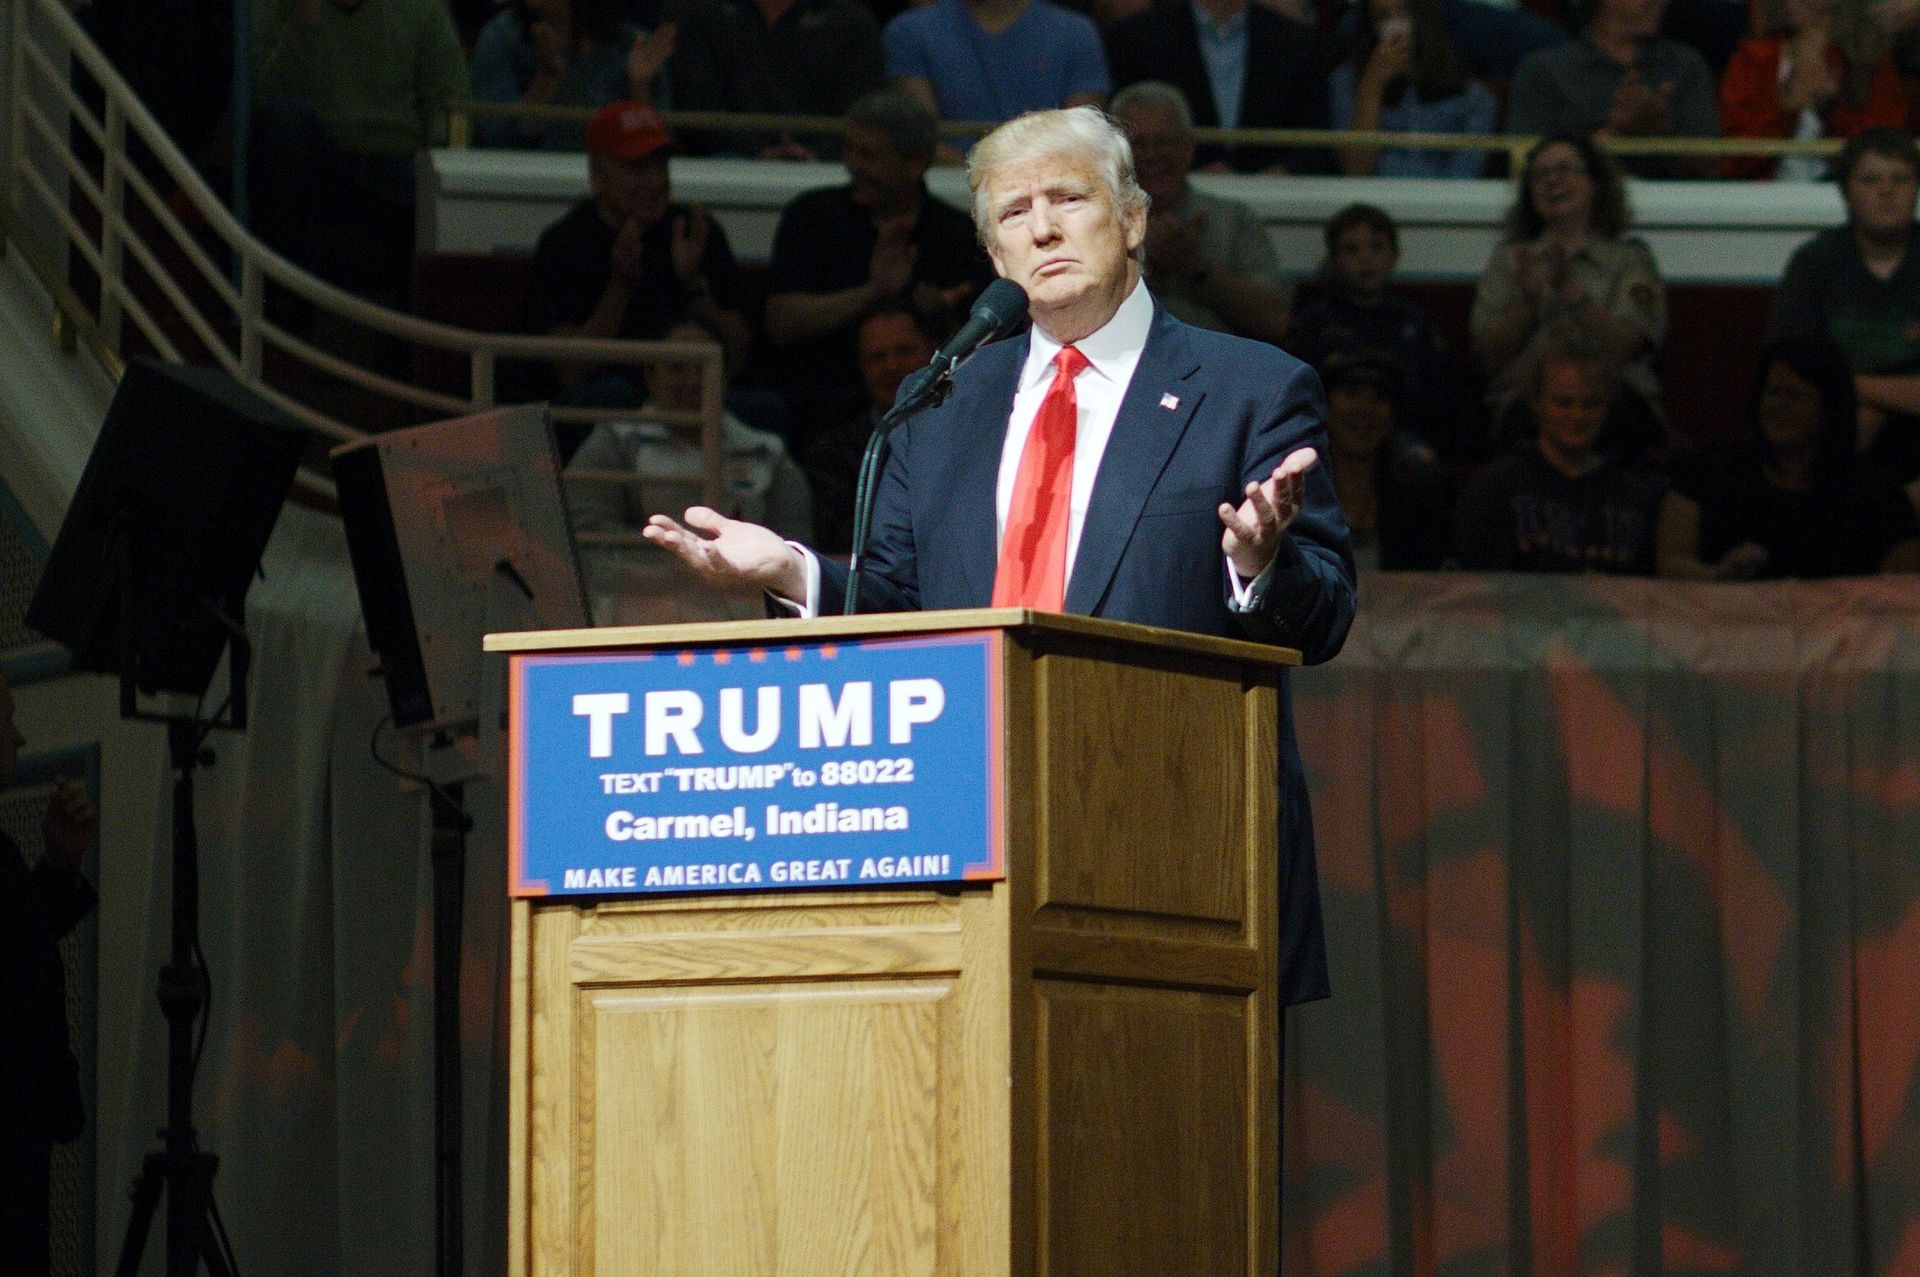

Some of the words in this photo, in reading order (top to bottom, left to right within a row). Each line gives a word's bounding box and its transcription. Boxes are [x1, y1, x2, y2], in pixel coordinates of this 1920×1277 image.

[572, 678, 946, 758] TRUMP
[600, 771, 664, 794] TEXT
[791, 767, 817, 787] to
[821, 757, 915, 786] 88022
[605, 806, 756, 842] Carmel,
[766, 802, 909, 835] Indiana
[563, 867, 636, 888] MAKE
[645, 862, 761, 886] AMERICA
[770, 858, 852, 883] GREAT
[860, 854, 950, 879] AGAIN!
